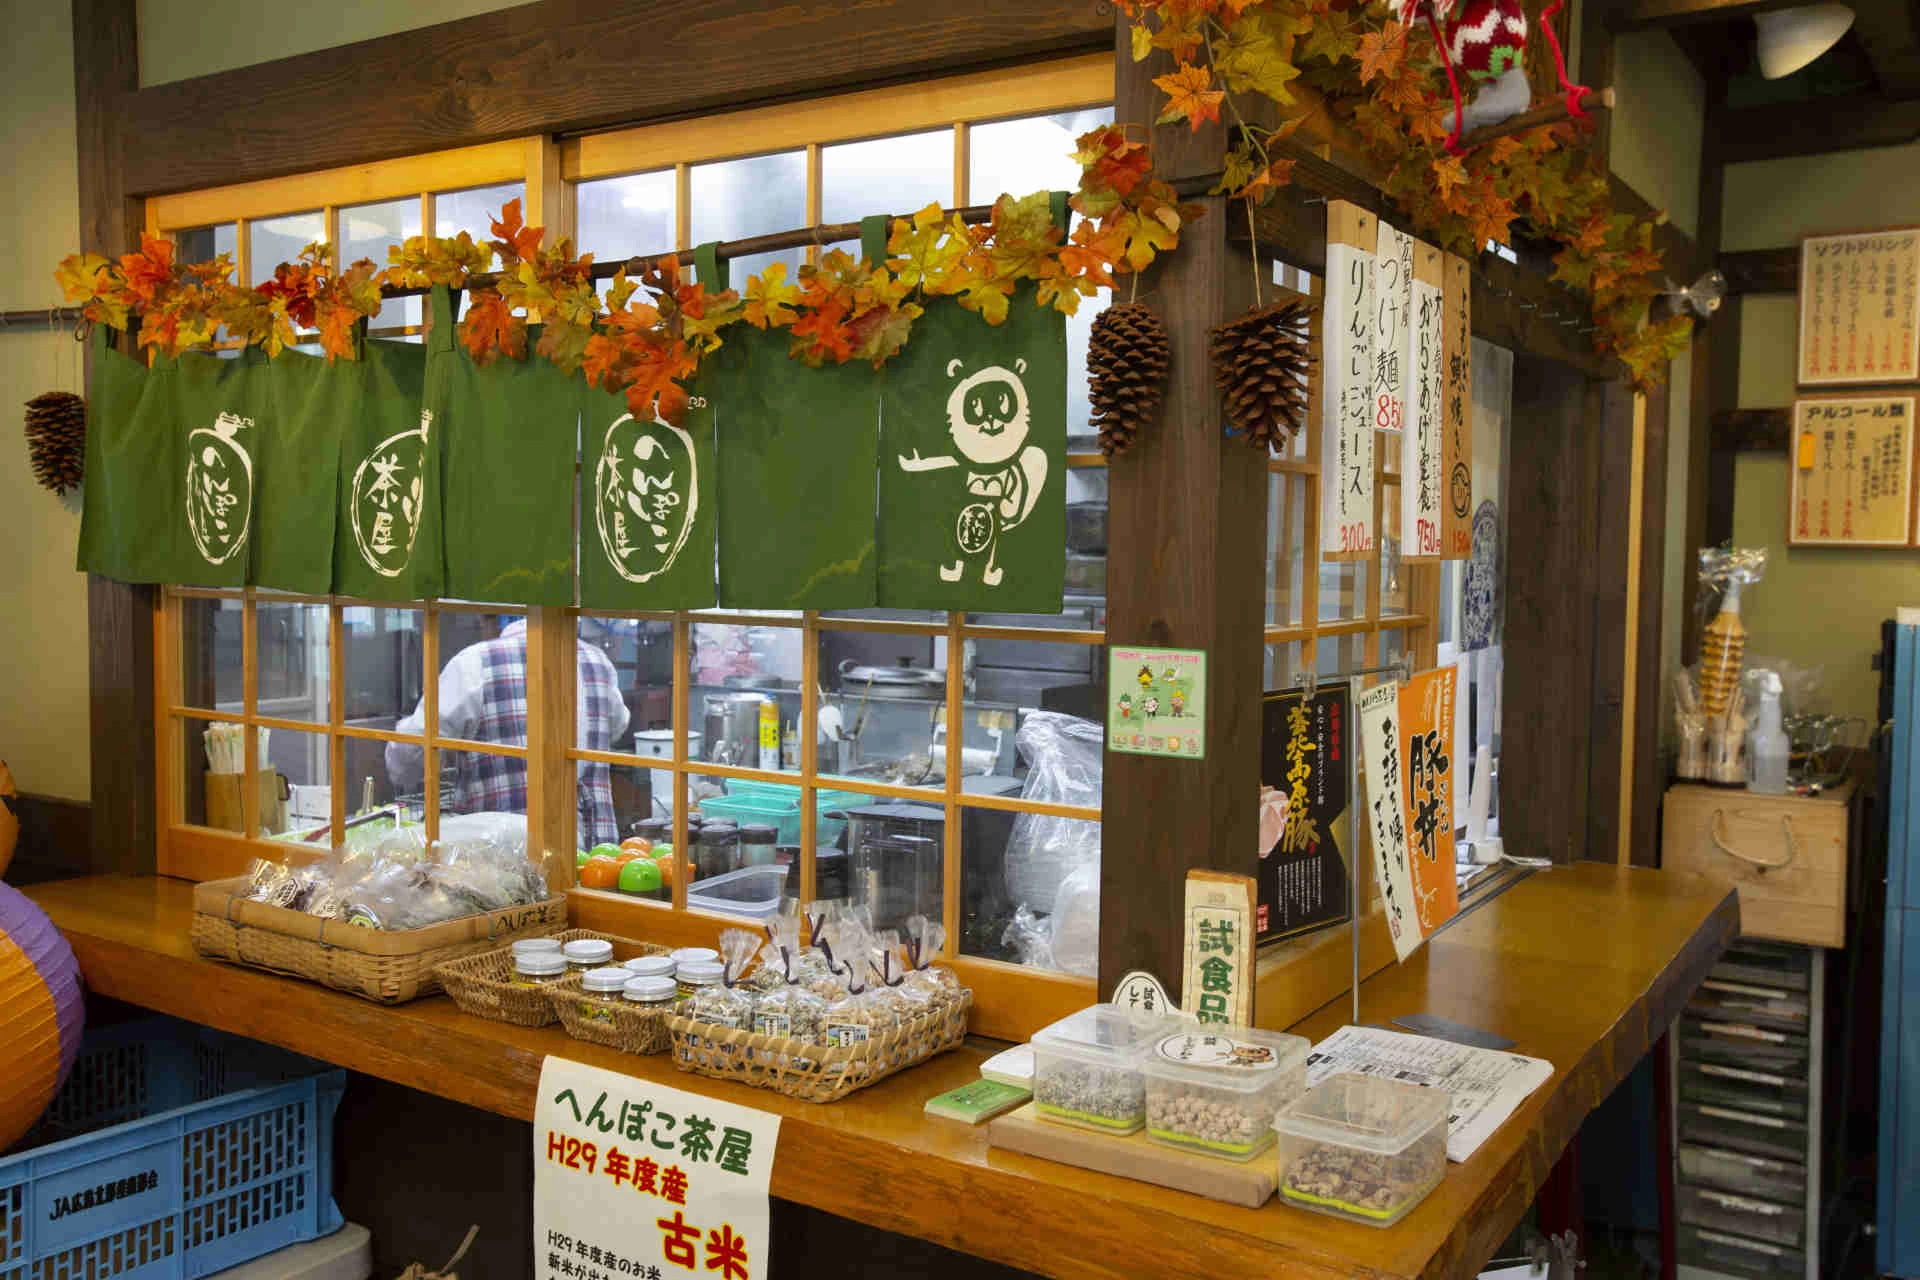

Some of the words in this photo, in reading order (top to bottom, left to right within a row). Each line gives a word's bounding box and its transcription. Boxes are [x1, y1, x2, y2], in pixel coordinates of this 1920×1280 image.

[1350, 259, 1368, 495] りんごジュース
[1375, 258, 1400, 393] つけ麺
[364, 453, 405, 554] 茶屋
[1410, 730, 1449, 862] 豚丼
[554, 1088, 753, 1176] へんぽこ茶屋
[656, 1211, 750, 1280] 古米
